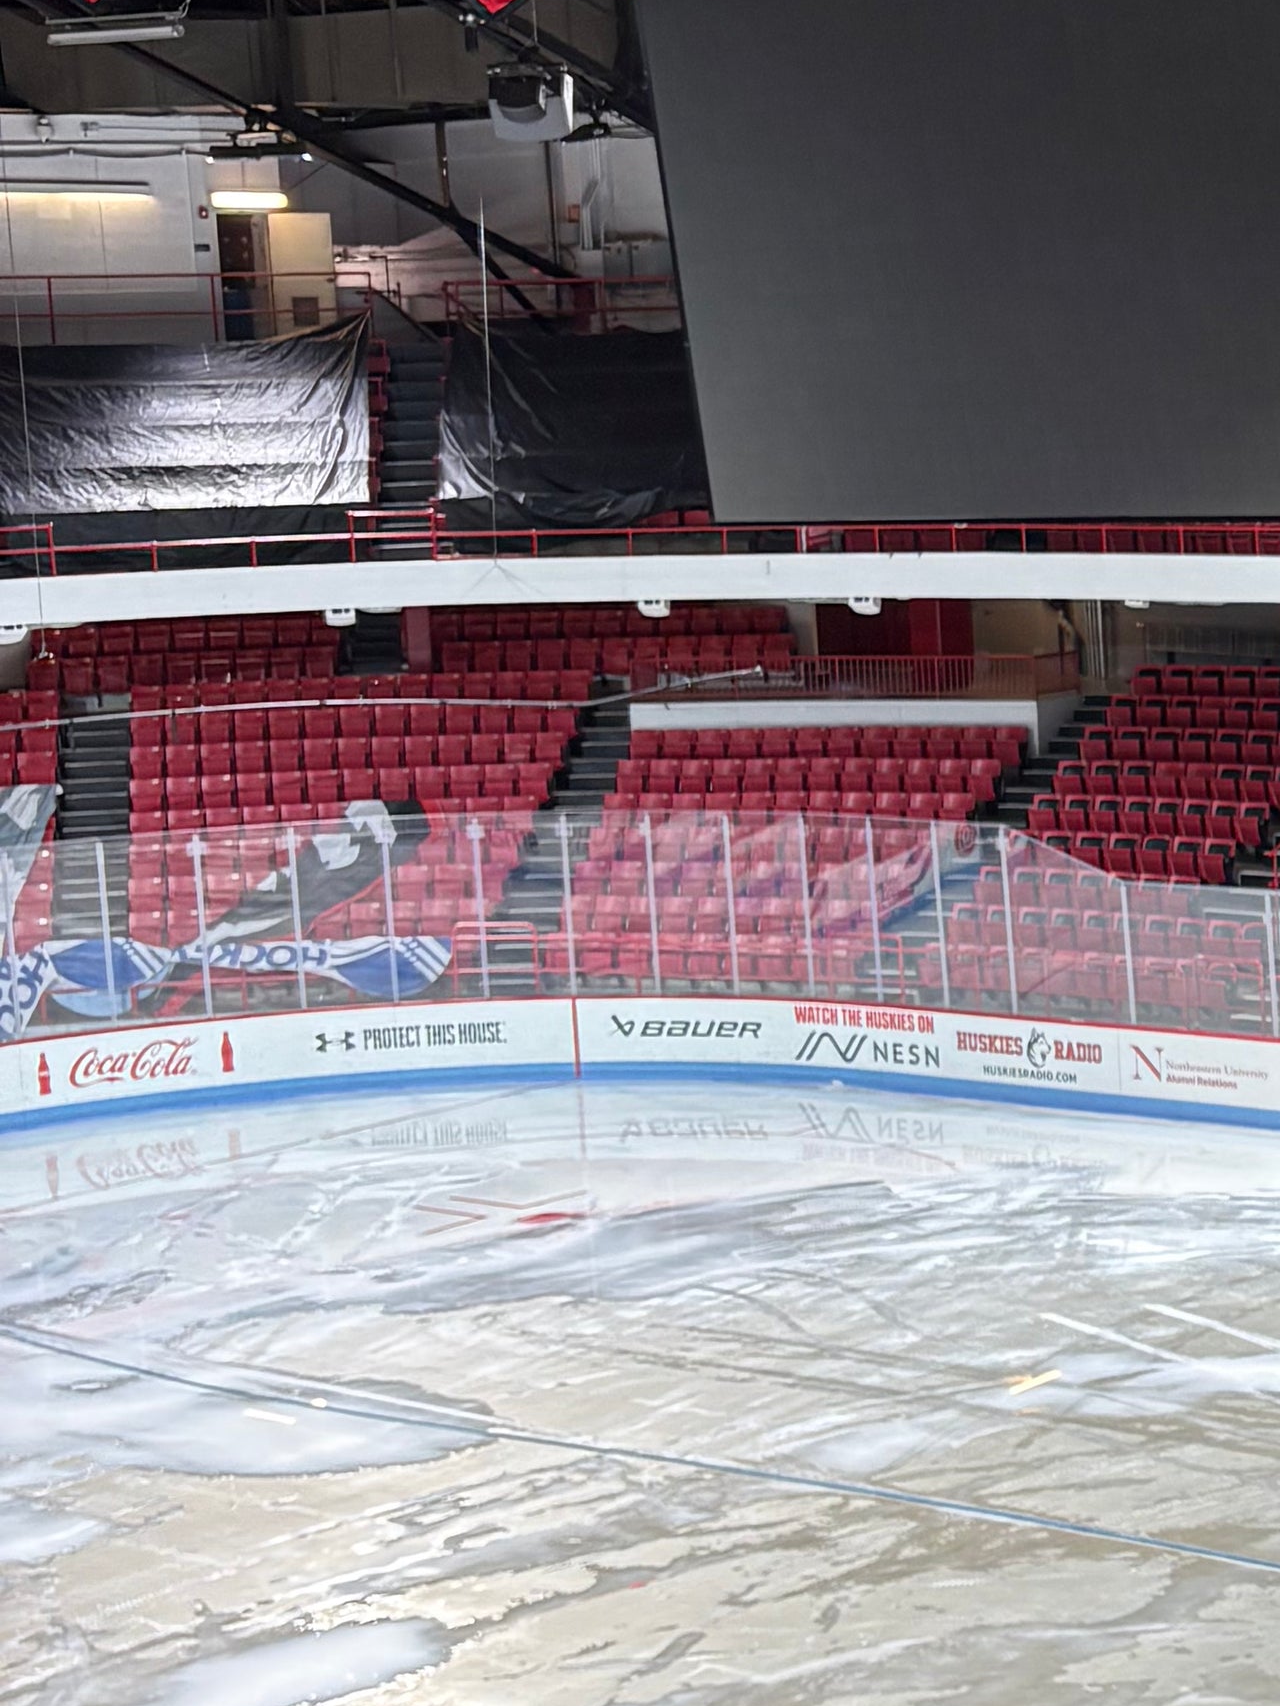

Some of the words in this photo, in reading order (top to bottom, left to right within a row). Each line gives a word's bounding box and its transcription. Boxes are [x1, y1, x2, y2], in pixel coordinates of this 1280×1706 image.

[794, 1006, 838, 1026] WATCH
[841, 1009, 863, 1028] THE
[865, 1011, 915, 1033] HUSKIES
[917, 1015, 935, 1034] ON
[363, 1025, 421, 1051] PROTECT
[424, 1024, 456, 1047] THIS
[956, 1031, 1023, 1057] HUSKIES
[1053, 1039, 1103, 1064] RADIO
[69, 1036, 198, 1089] Coca-Cola
[873, 1040, 941, 1068] NESN
[1130, 1044, 1164, 1083] N
[982, 1064, 1077, 1083] HUSKIESRADIO.COM
[1165, 1060, 1222, 1075] Northeastern
[1224, 1066, 1269, 1080] University
[1166, 1074, 1196, 1087] Alumni
[1197, 1078, 1238, 1090] Relations
